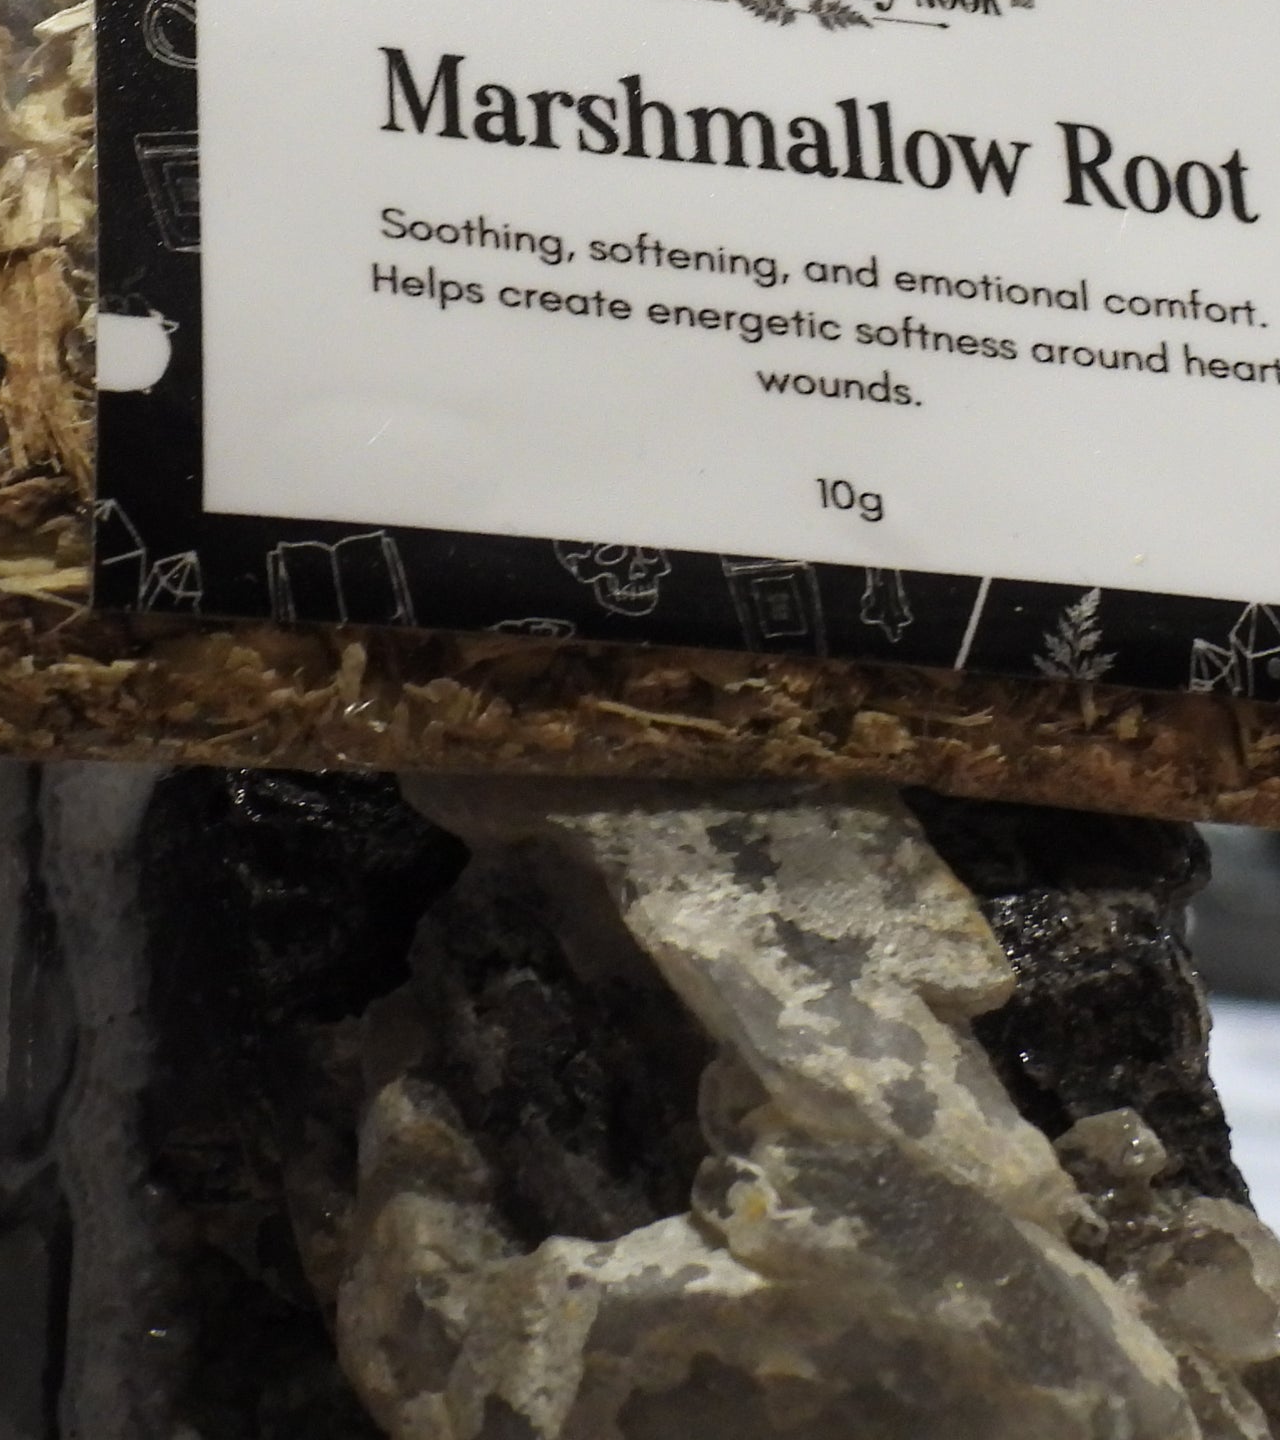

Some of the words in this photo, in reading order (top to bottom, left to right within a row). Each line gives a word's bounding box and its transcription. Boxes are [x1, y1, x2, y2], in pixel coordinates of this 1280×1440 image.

[377, 46, 1033, 199] Marshmallow
[1054, 120, 1262, 225] Root
[371, 262, 486, 311] Helps
[497, 286, 633, 321] create
[646, 302, 842, 345] energetic
[854, 315, 1019, 361] softness
[1030, 340, 1171, 375] around
[380, 207, 576, 267] Soothing,
[588, 231, 790, 289] softening,
[802, 254, 880, 289] and
[893, 270, 1089, 312] emotional
[1102, 288, 1269, 329] comfort.
[755, 369, 923, 408] wounds.
[815, 477, 885, 523] 10g
